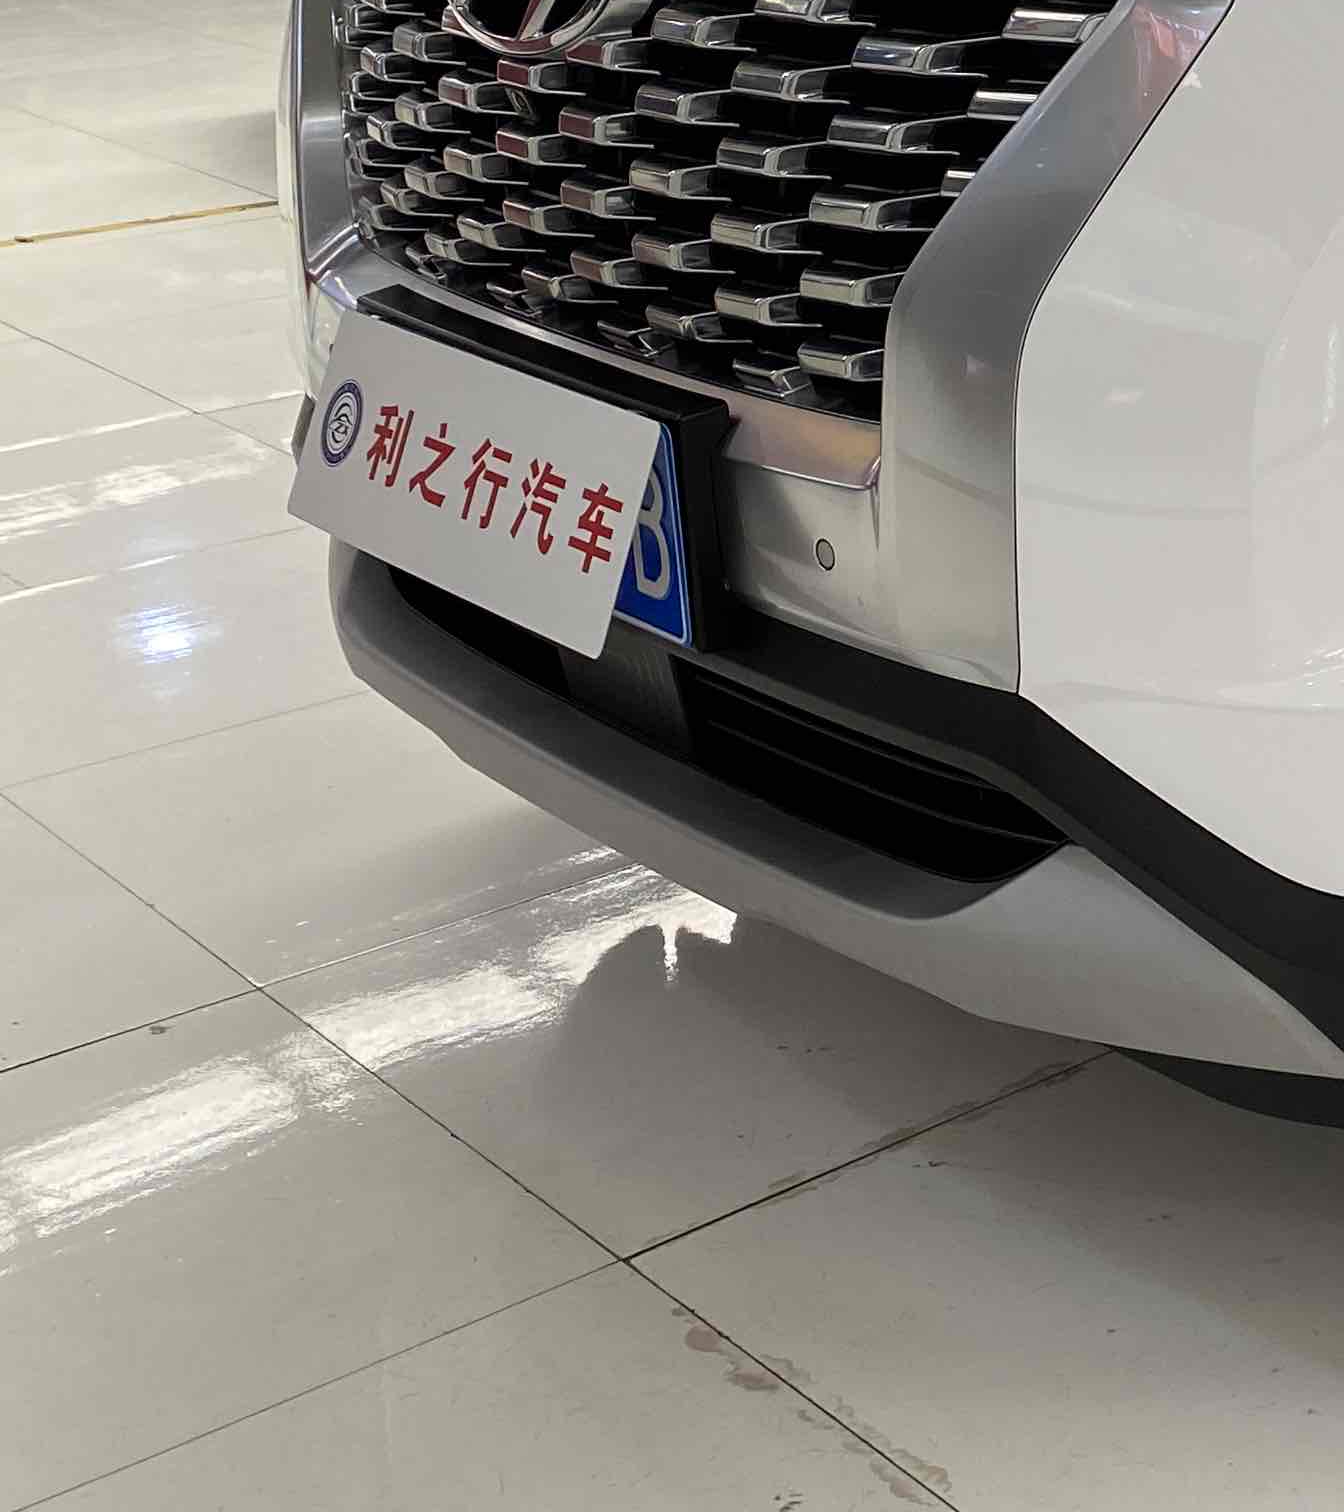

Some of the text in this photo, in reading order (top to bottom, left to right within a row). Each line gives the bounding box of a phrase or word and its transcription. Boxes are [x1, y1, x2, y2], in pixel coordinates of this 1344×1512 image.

[366, 405, 624, 573] 利之行汽车
